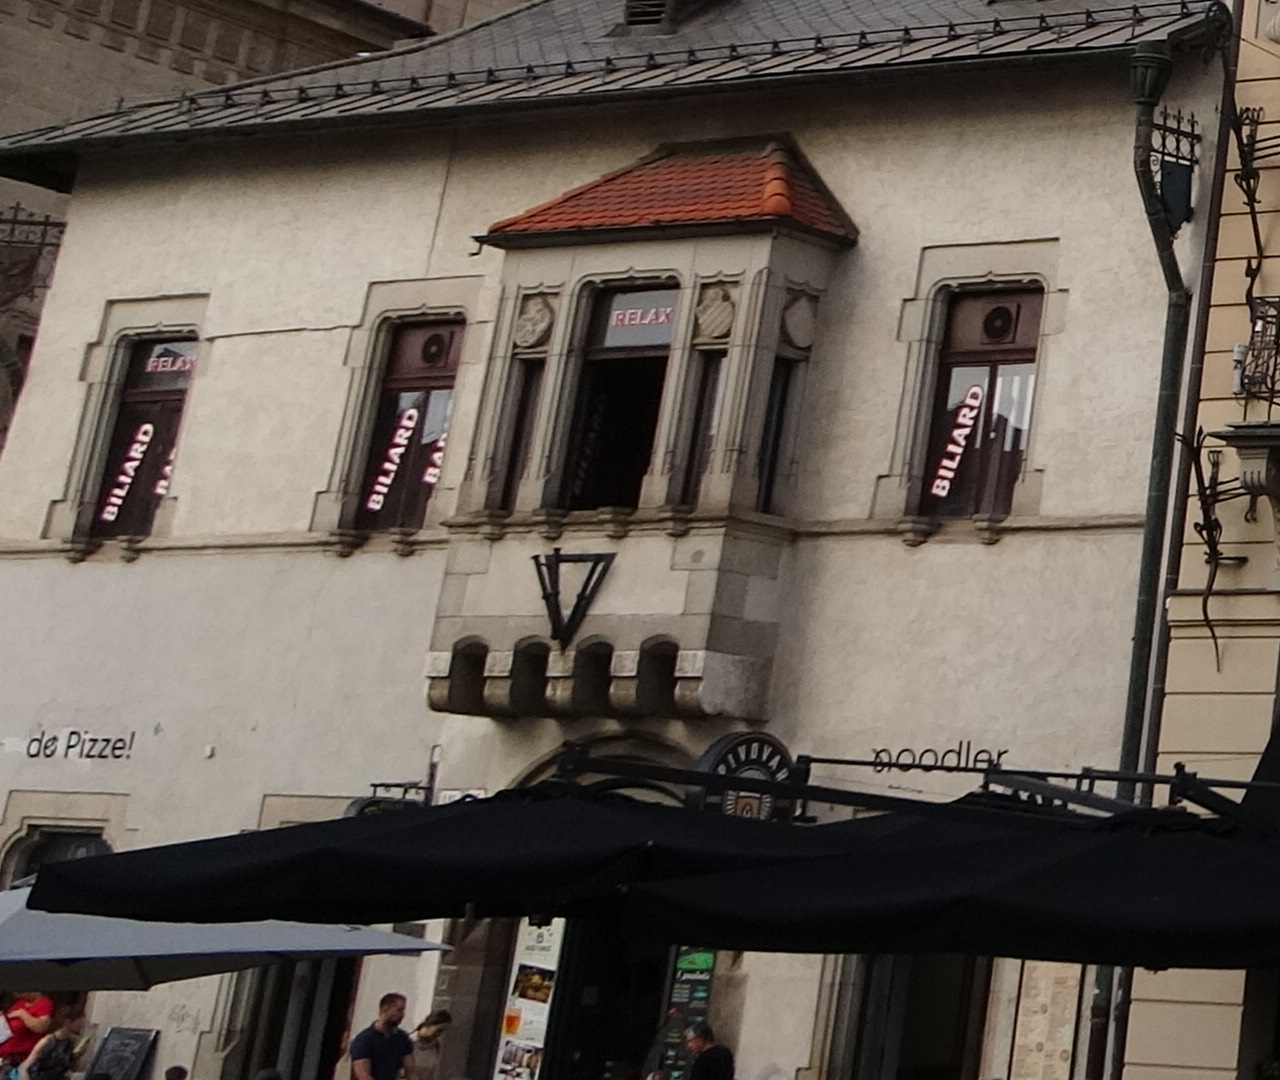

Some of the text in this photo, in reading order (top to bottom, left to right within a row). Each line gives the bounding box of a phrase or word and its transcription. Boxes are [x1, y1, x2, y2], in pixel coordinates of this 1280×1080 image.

[612, 307, 673, 326] RELAX
[102, 423, 154, 521] BILIARD
[367, 408, 419, 511] BILIARD
[936, 385, 985, 498] BILIARD
[64, 731, 136, 759] Pizze!
